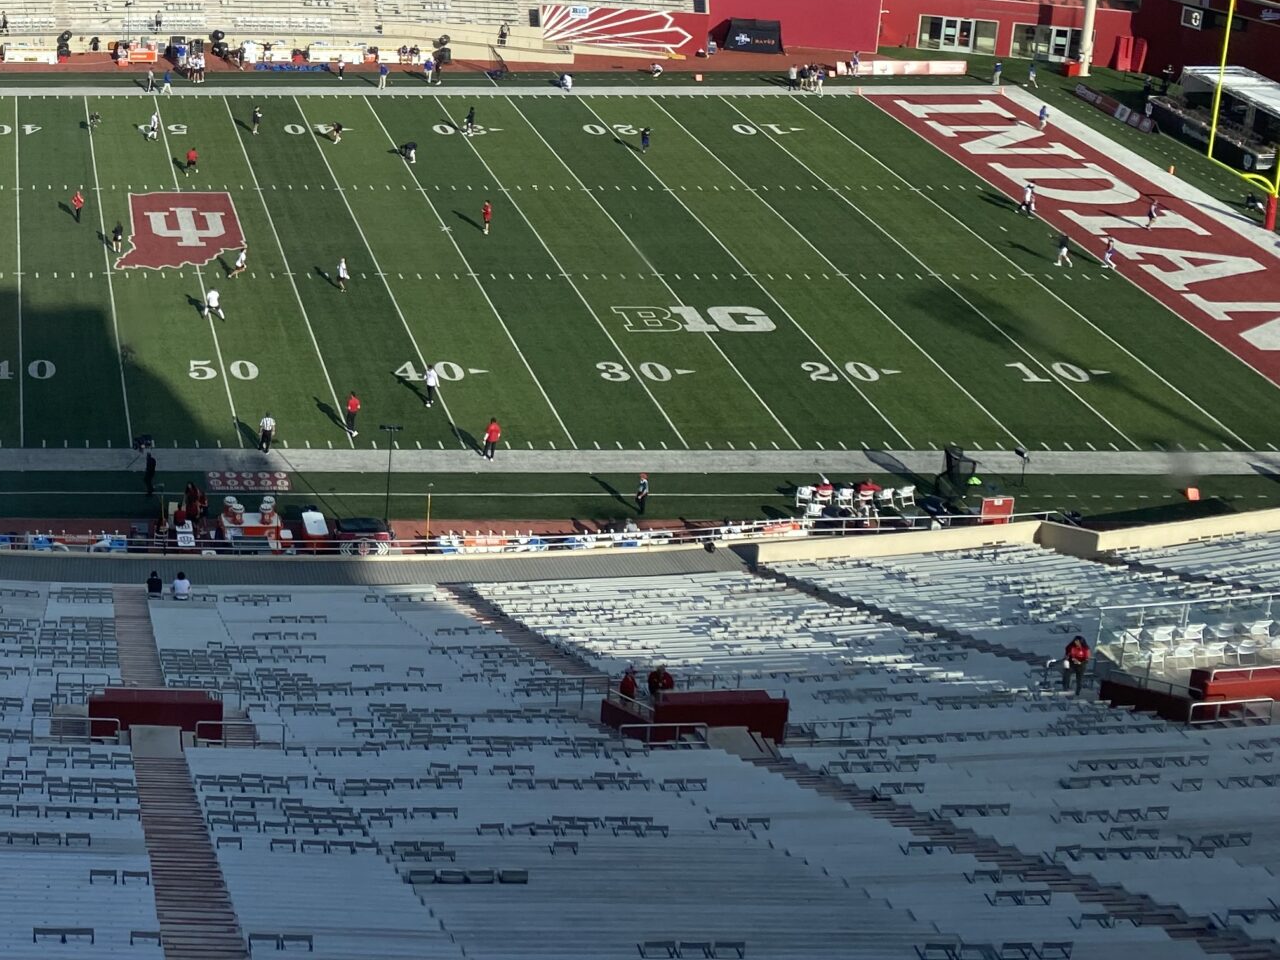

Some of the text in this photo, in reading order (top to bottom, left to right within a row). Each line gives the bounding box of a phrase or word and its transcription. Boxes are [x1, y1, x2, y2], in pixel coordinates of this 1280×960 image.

[189, 360, 259, 381] 50
[394, 361, 465, 382] 40
[596, 361, 672, 382] 30
[801, 361, 880, 383] 20
[1005, 361, 1090, 383] 10
